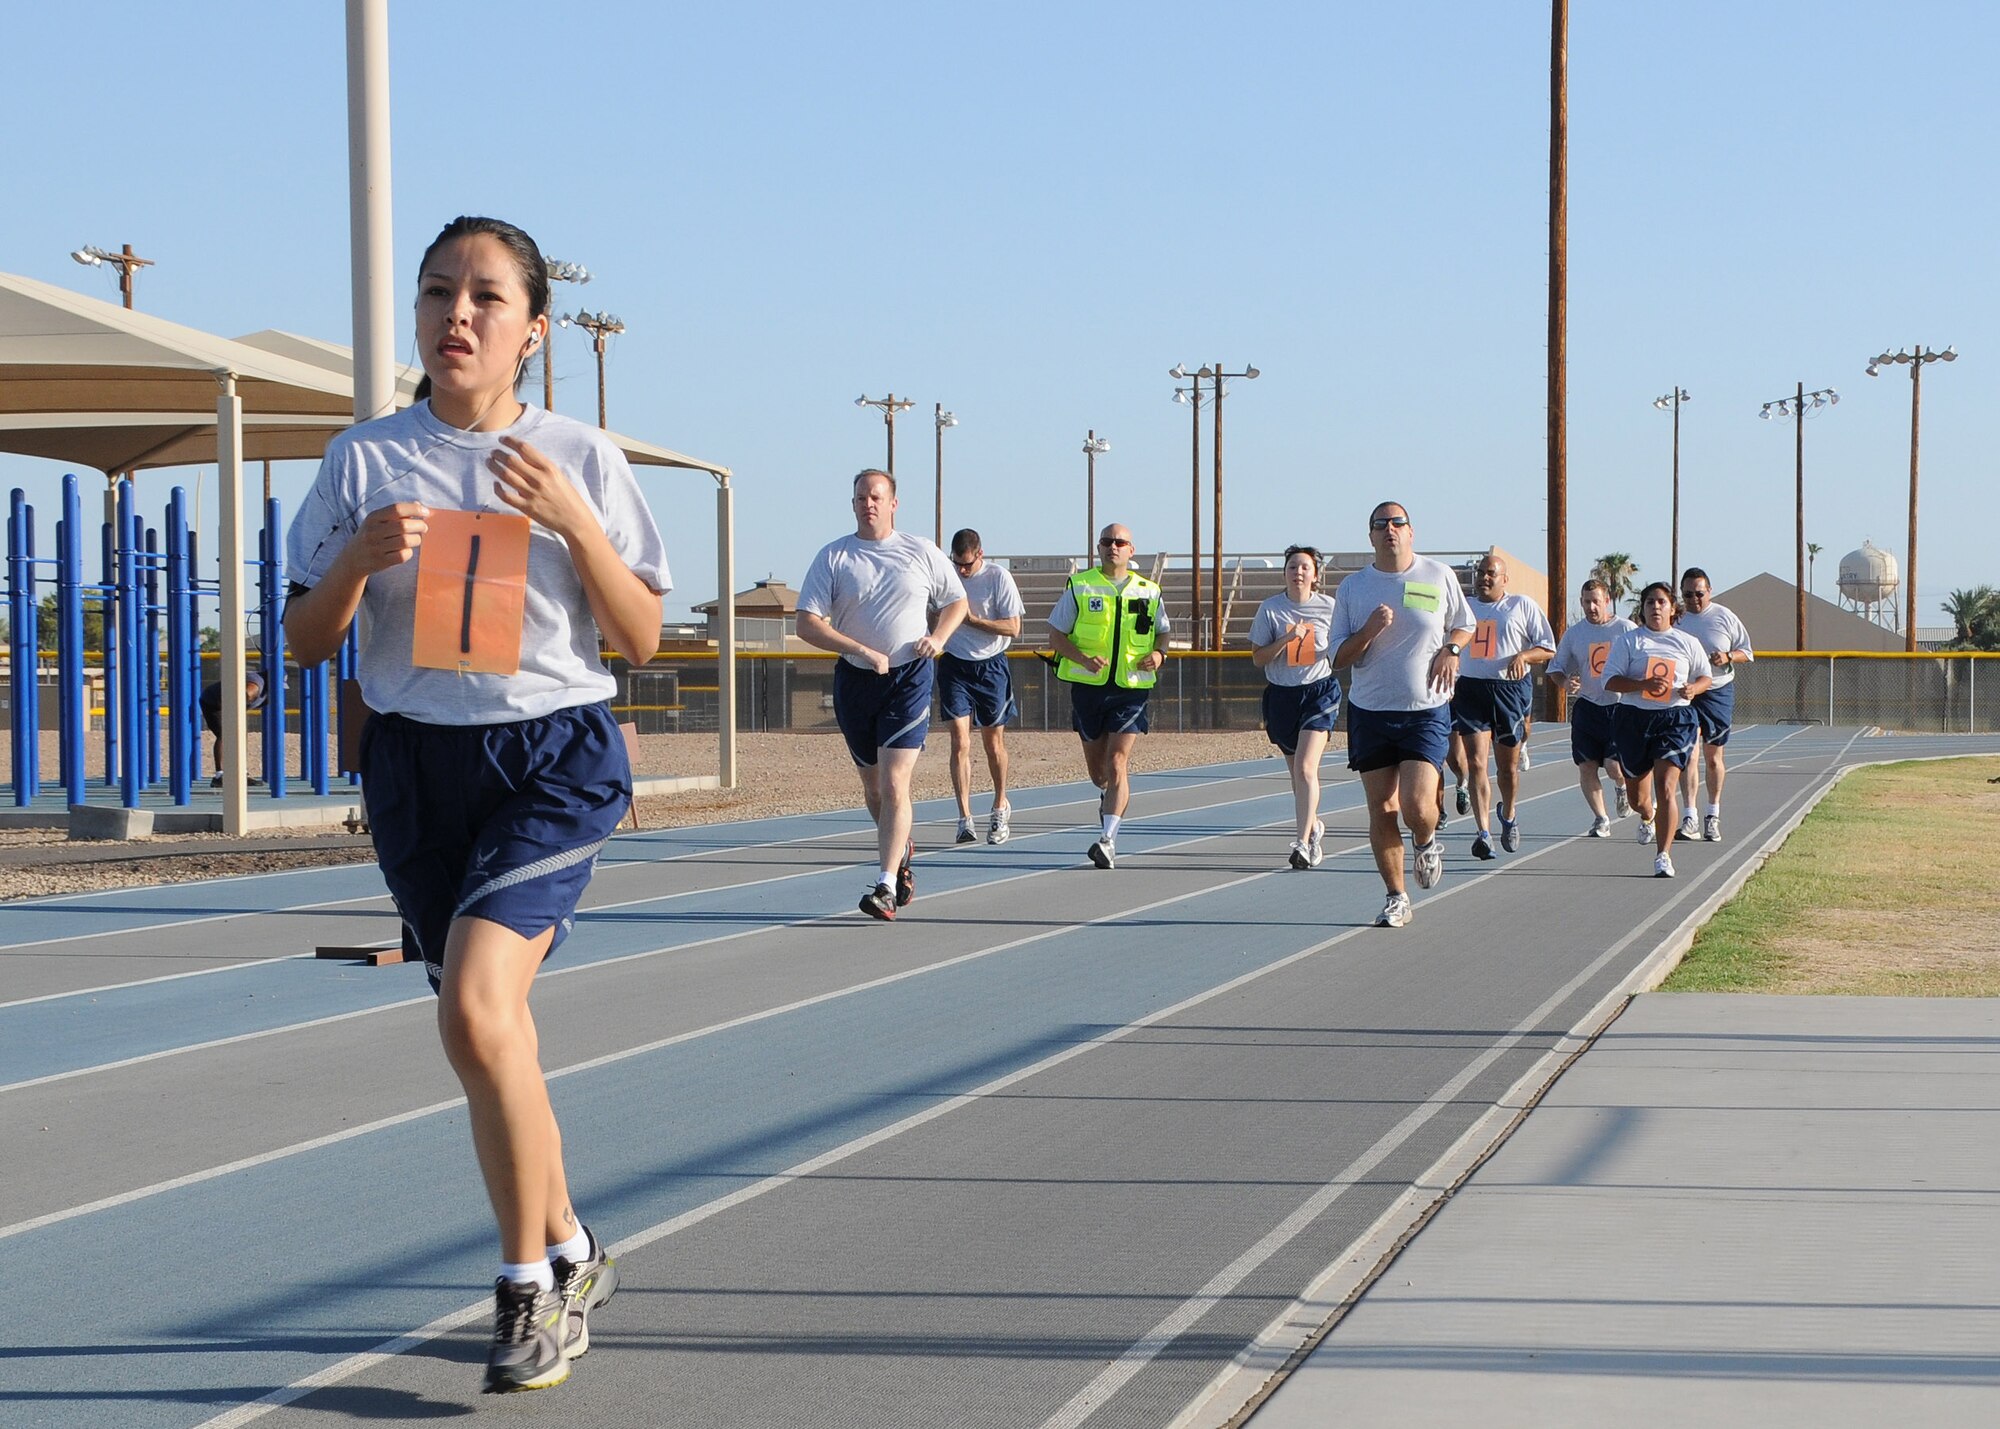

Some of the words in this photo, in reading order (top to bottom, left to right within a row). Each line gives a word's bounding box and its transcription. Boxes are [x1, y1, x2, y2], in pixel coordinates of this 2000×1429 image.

[461, 534, 480, 653] 1
[1475, 625, 1490, 657] 4
[1591, 646, 1607, 674] 6
[1646, 662, 1669, 698] 8
